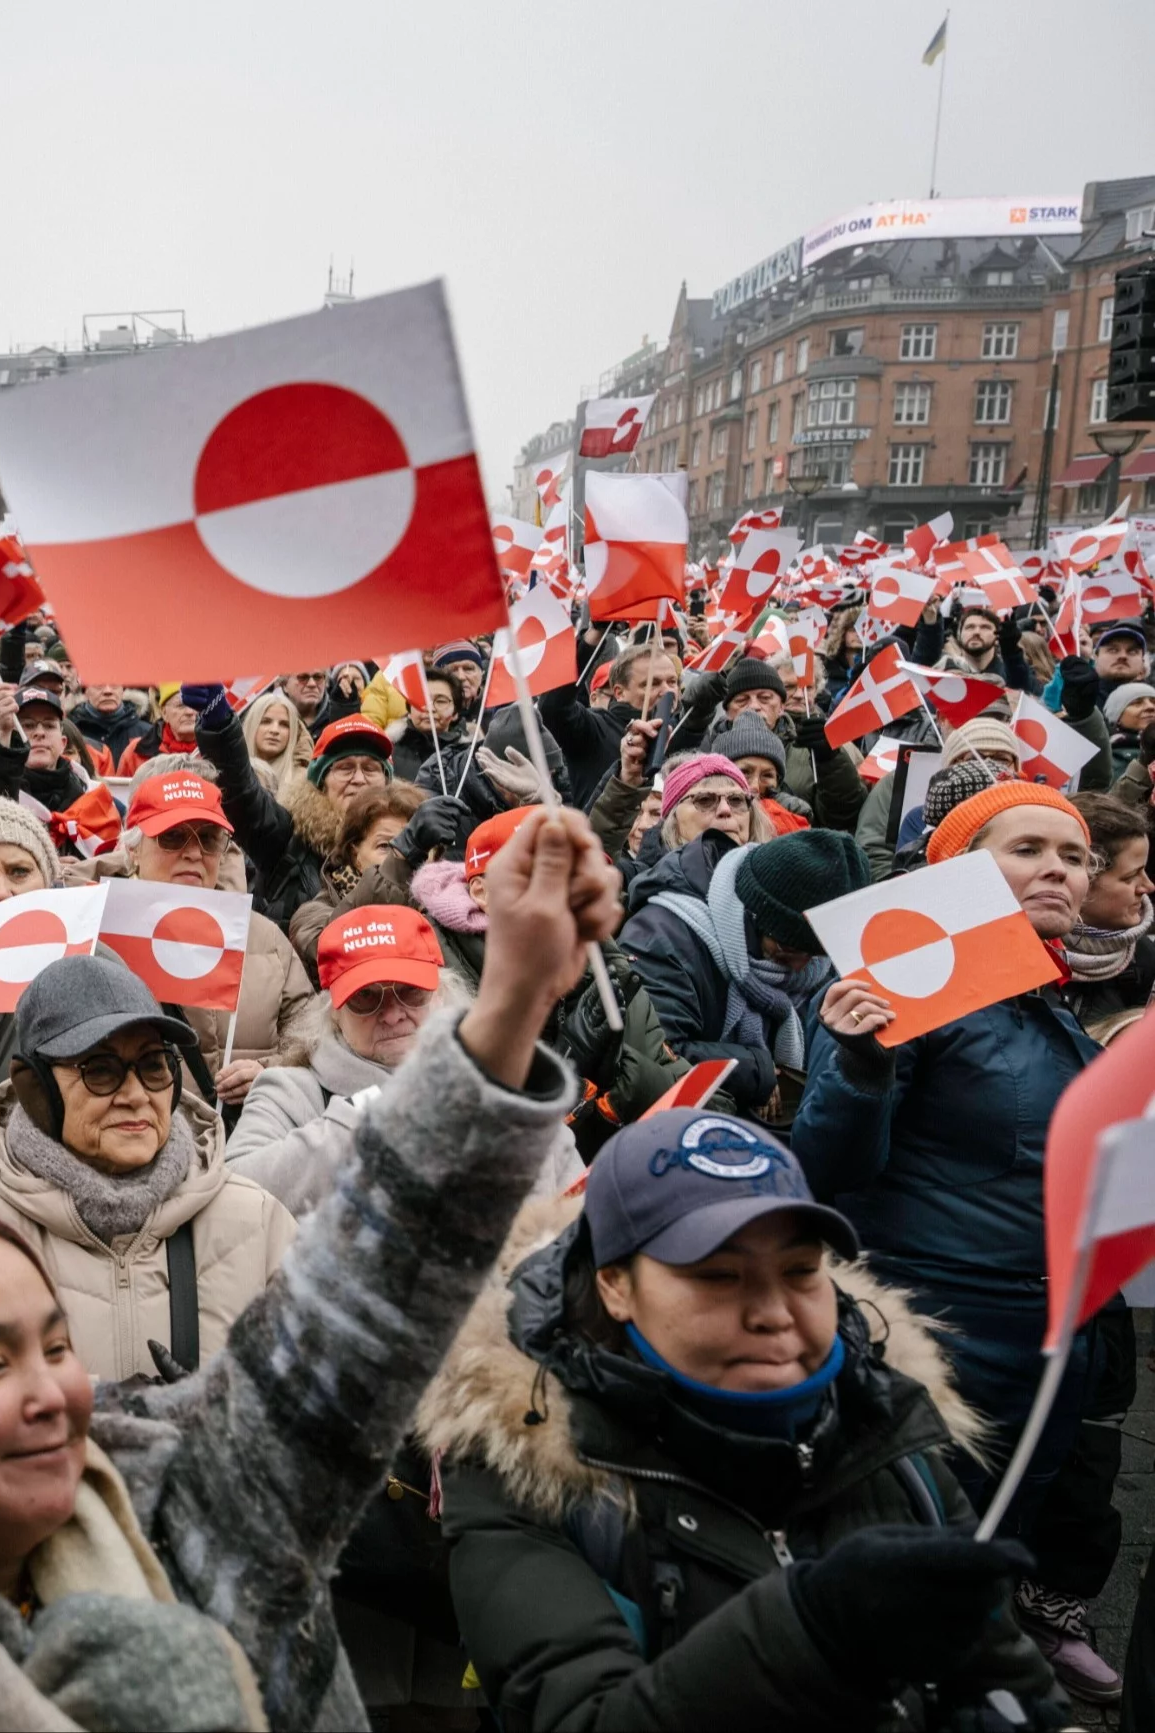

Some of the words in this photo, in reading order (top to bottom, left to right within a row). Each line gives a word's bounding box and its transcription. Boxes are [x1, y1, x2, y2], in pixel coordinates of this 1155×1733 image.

[1029, 206, 1077, 218] STARK
[848, 217, 872, 232] OM
[876, 215, 897, 228] AT
[711, 238, 802, 320] POLITIKEN
[793, 428, 872, 443] LITIKEN
[162, 782, 179, 791] Nu
[182, 779, 202, 789] det
[164, 789, 204, 801] NUUK!
[342, 926, 363, 939] Nu
[366, 922, 394, 932] det
[343, 935, 397, 953] NUUK!
